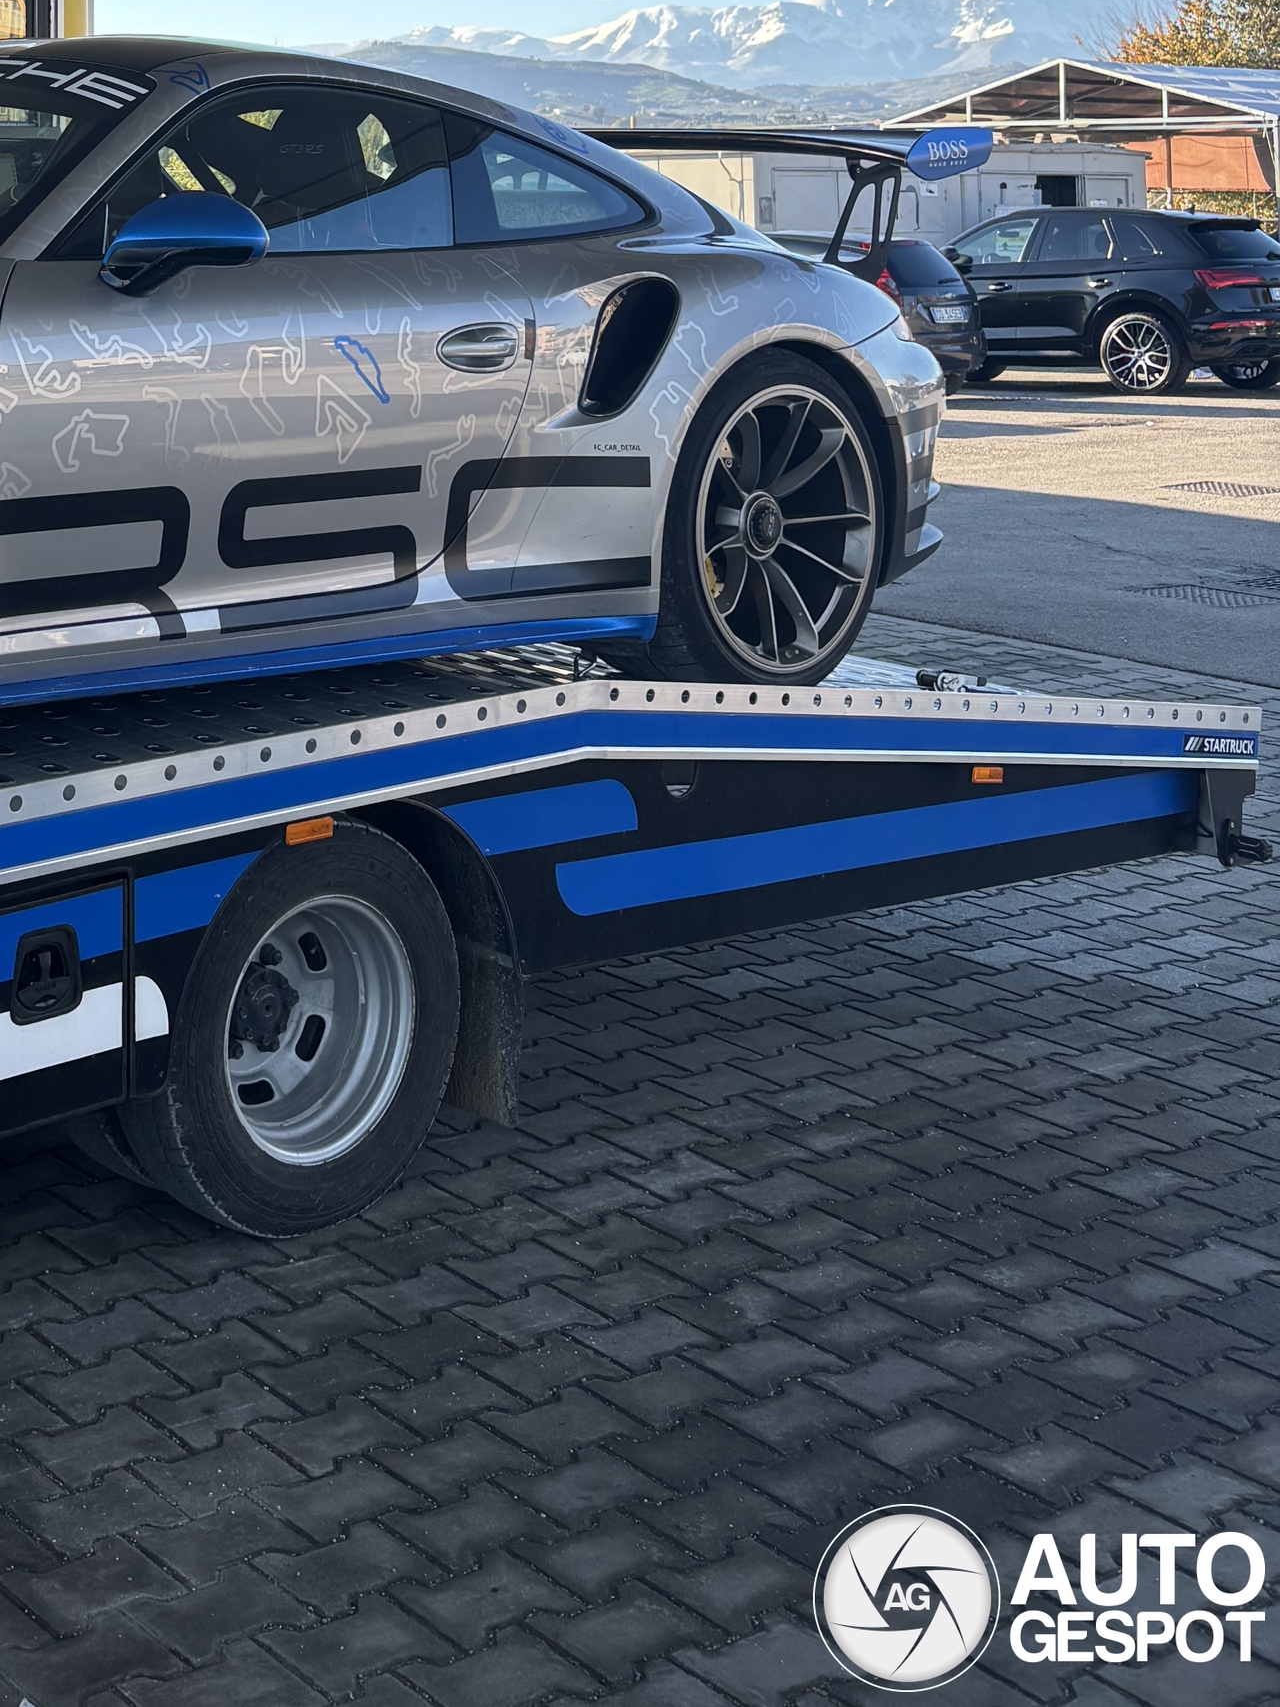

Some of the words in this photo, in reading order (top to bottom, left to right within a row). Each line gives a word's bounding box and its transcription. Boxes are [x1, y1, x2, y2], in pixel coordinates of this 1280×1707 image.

[927, 139, 969, 161] BOSS
[593, 444, 641, 452] FC_CAR_DETAIL
[1203, 737, 1254, 754] STARTRUCK
